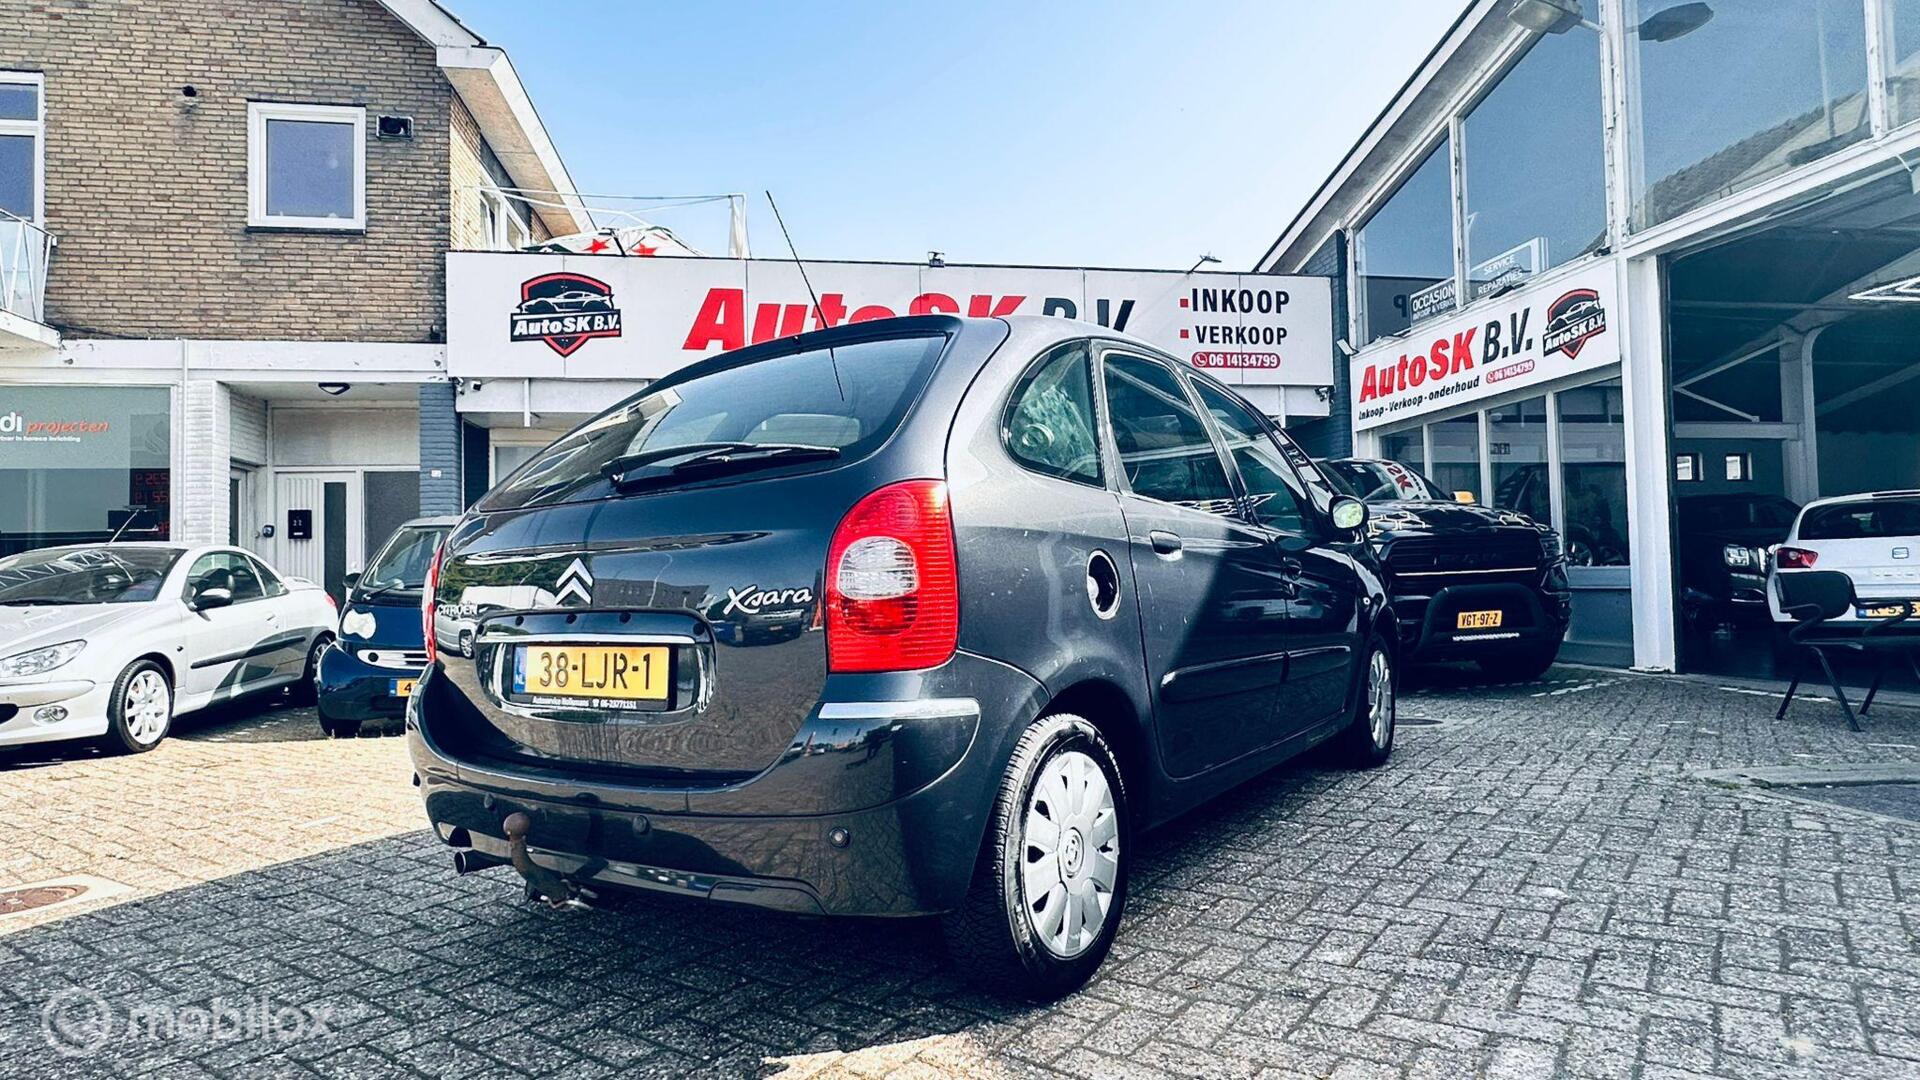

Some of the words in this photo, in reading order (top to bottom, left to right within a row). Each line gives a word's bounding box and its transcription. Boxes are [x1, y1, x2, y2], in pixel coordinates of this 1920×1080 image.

[1484, 255, 1515, 275] SERVICE
[1192, 288, 1290, 314] INKOOP
[513, 316, 592, 336] AutoSK
[594, 314, 620, 331] B.V.
[1195, 325, 1288, 345] VERKOOP
[1544, 319, 1588, 351] AutoSK
[1588, 313, 1605, 331] B.V.
[1209, 353, 1224, 366] 06
[1227, 354, 1278, 367] 14134799
[1359, 326, 1478, 403] AutoSK
[1482, 307, 1533, 365] B.V.
[1428, 376, 1480, 400] onderhoud
[26, 420, 109, 436] projecten
[722, 585, 812, 615] Xsara
[539, 652, 651, 690] 38-LJR-1
